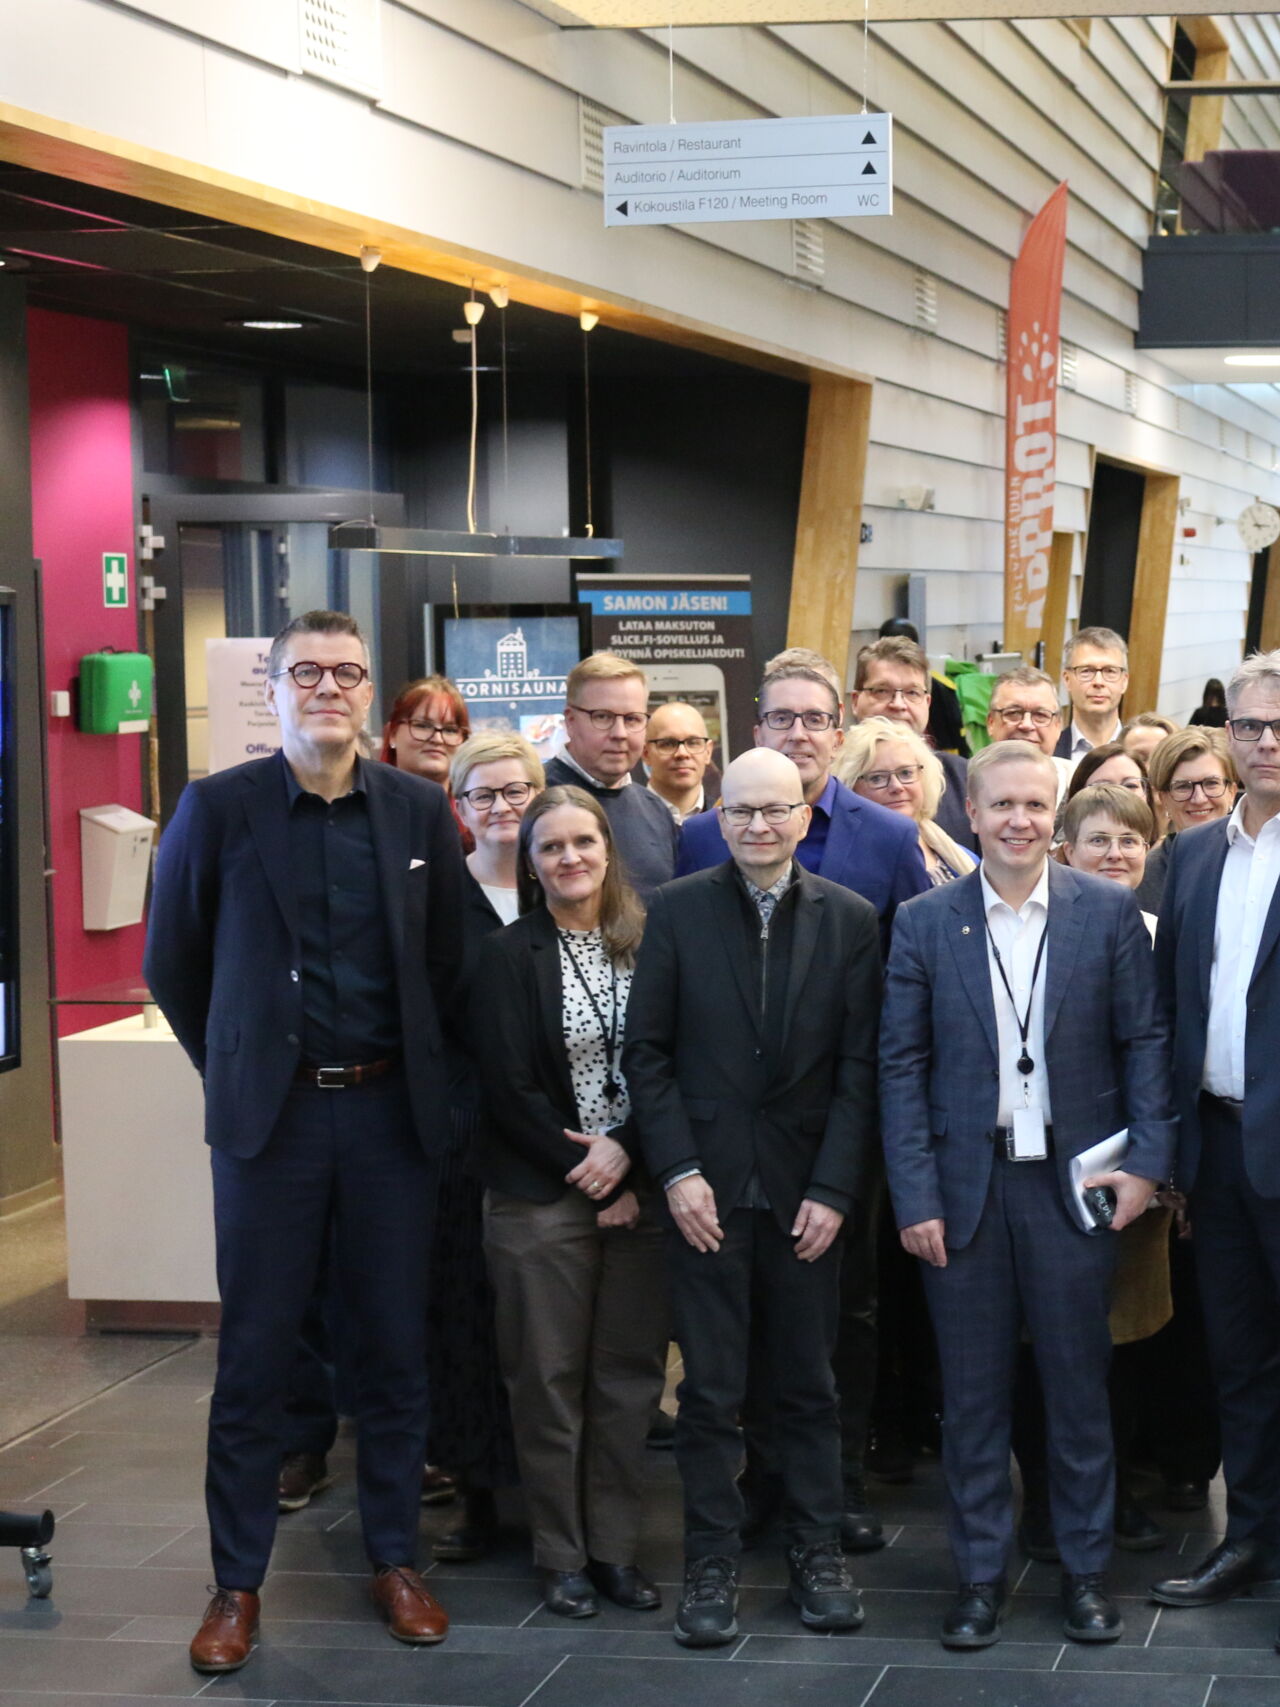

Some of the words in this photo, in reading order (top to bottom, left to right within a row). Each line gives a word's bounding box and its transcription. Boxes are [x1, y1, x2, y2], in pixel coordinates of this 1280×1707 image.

[613, 140, 667, 154] Ravintola
[669, 139, 675, 152] /
[678, 137, 742, 151] Restaurant
[614, 169, 667, 184] Auditorio
[669, 169, 675, 183] /
[677, 167, 742, 182] Auditorium
[634, 196, 696, 213] Kokoustila
[699, 196, 729, 210] F120
[731, 196, 738, 209] /
[740, 195, 789, 209] Meeting
[791, 192, 828, 206] Room
[857, 194, 880, 207] WC
[603, 595, 668, 611] SAMON
[671, 592, 728, 611] JÄSEN!
[618, 620, 653, 631] LATAA
[654, 620, 715, 631] MAKSUTON
[610, 634, 710, 645] SLICE.FI-SOVELLUS
[711, 634, 724, 645] JA
[654, 648, 745, 659] OPISKELIJAEDUT!
[456, 681, 568, 697] TORNISAUNA
